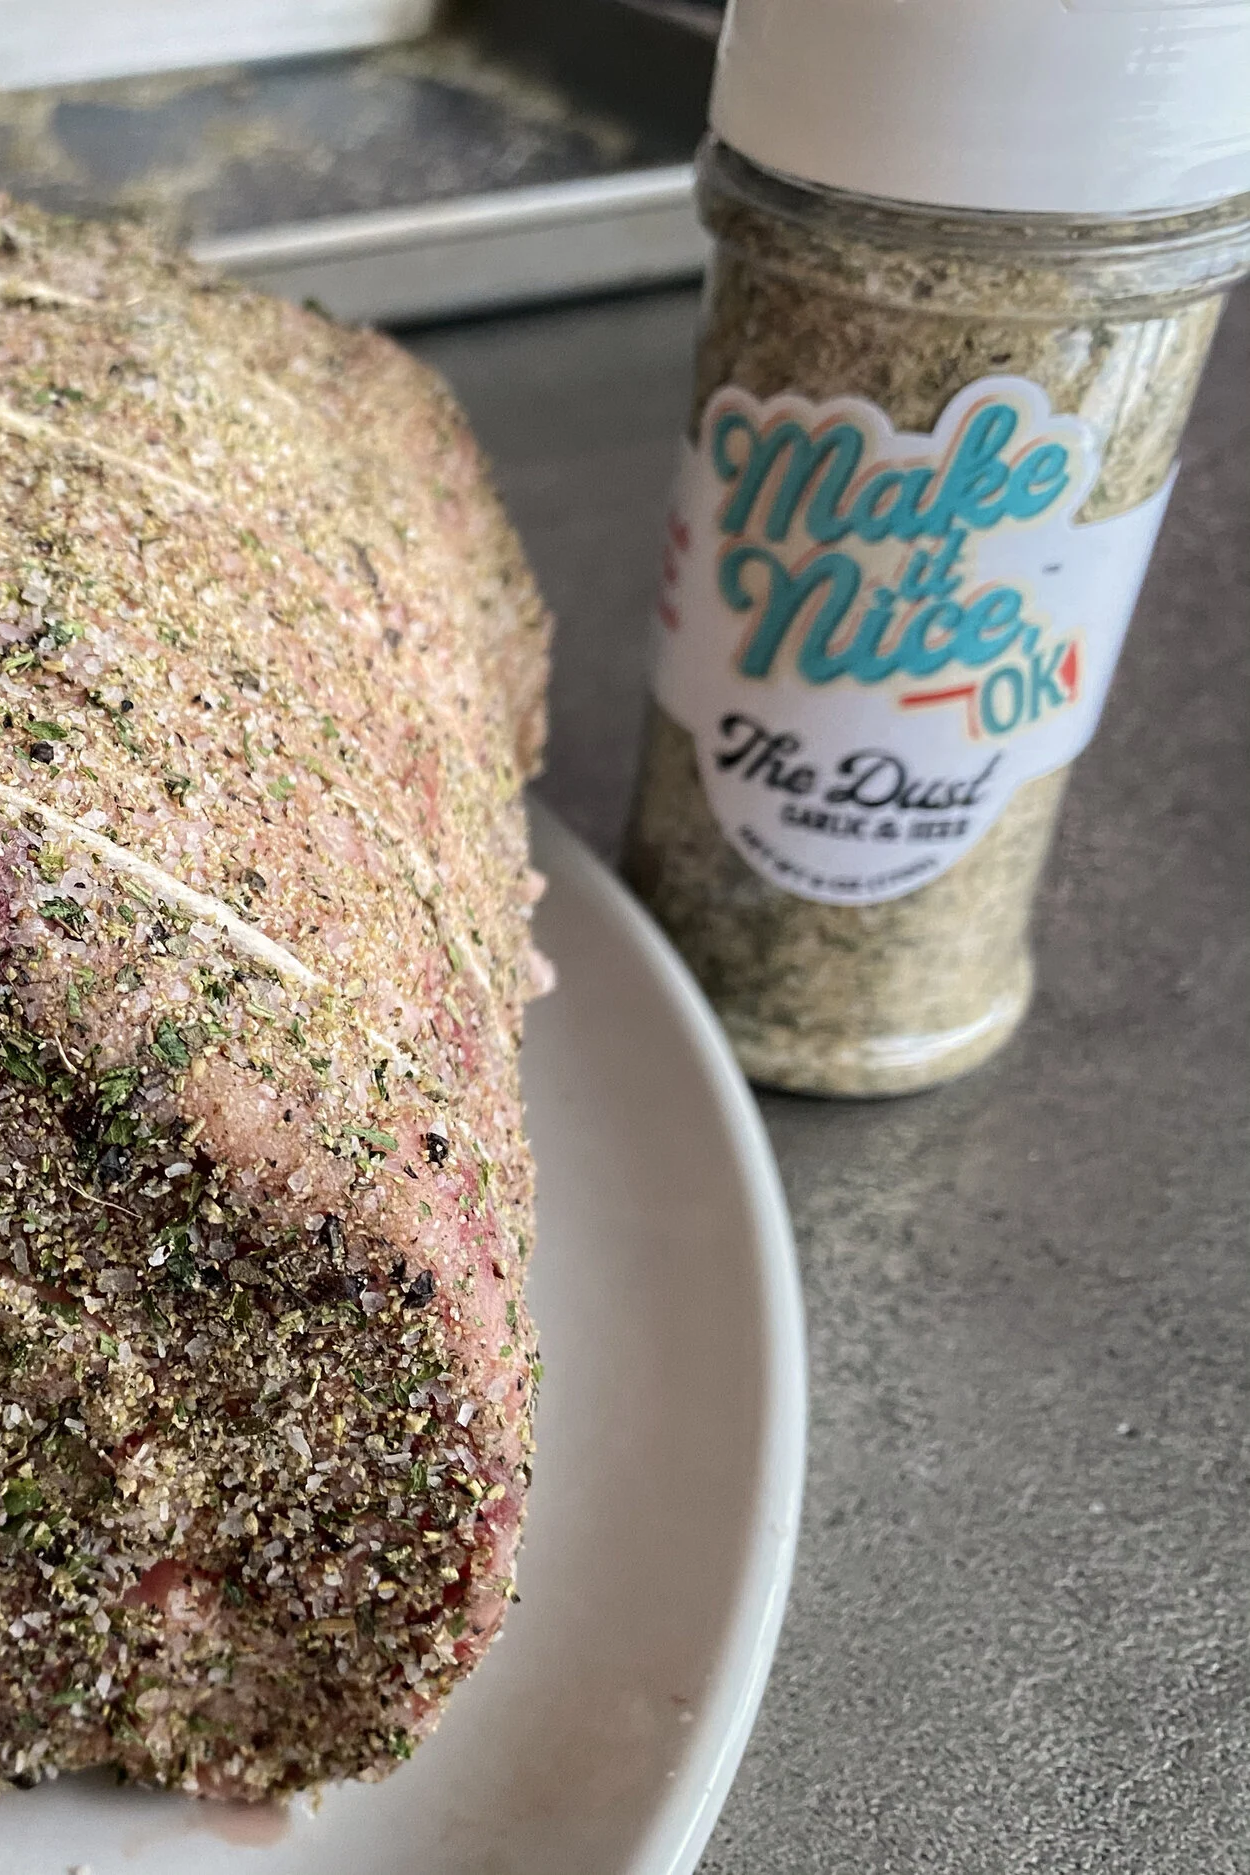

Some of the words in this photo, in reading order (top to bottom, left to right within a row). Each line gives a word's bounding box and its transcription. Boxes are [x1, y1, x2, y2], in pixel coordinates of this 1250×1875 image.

[713, 403, 1069, 544] Make
[902, 527, 965, 600] it
[980, 642, 1067, 736] OK
[715, 712, 816, 795] The
[824, 748, 1002, 809] Dust
